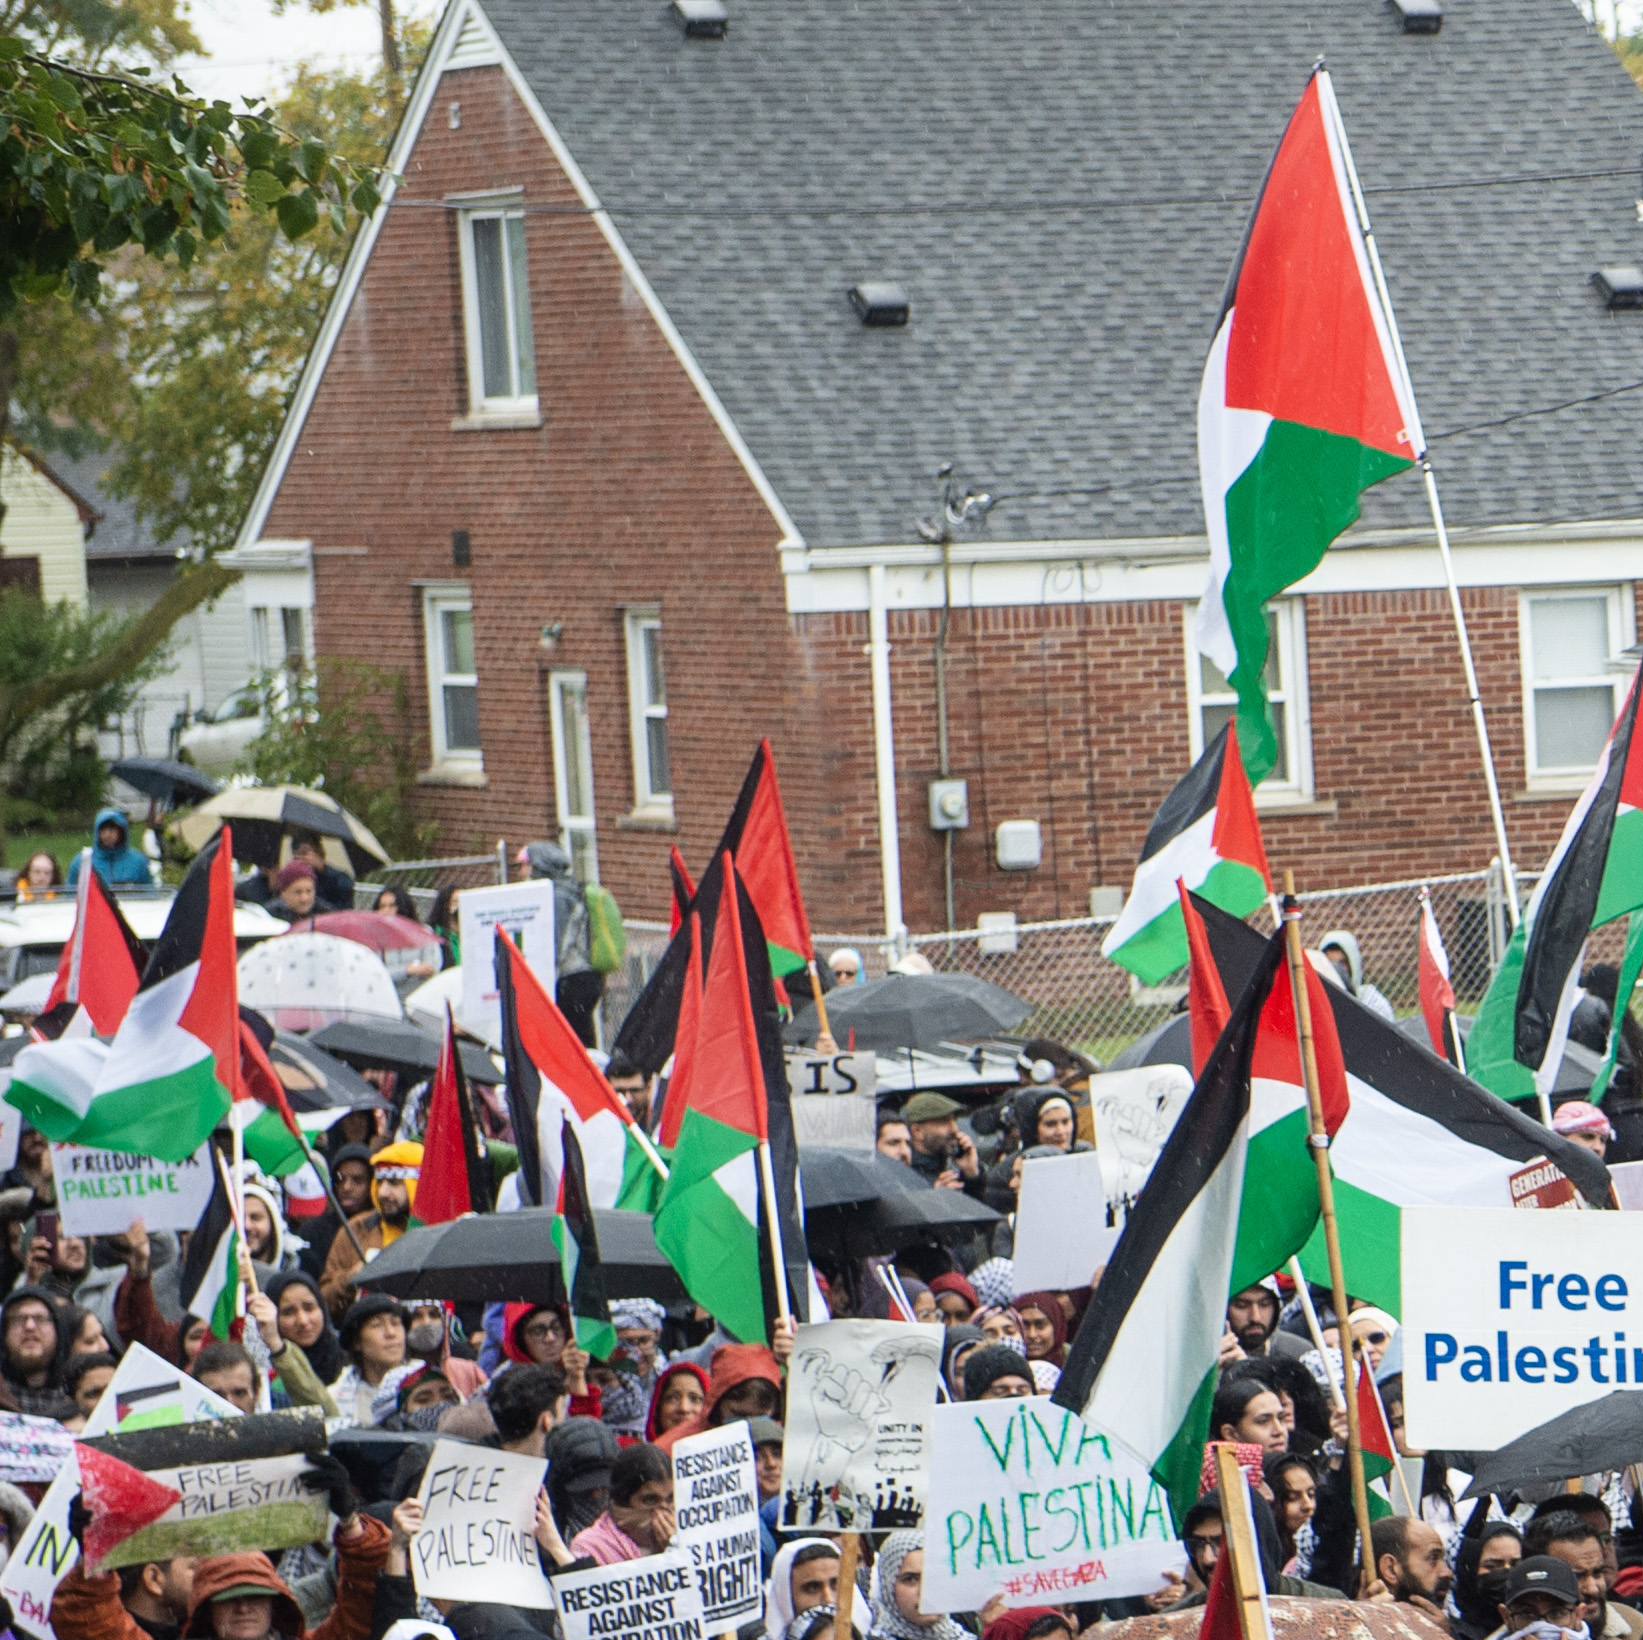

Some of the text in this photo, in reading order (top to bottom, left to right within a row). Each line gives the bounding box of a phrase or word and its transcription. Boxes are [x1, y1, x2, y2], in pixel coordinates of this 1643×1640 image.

[803, 1056, 857, 1094] IS
[62, 1172, 180, 1200] PALESTINE
[1511, 1163, 1567, 1198] GENERATI
[1499, 1261, 1629, 1311] Free
[878, 1423, 923, 1434] UNITY IN
[975, 1404, 1111, 1476] VIVA
[178, 1462, 254, 1492] FREE
[675, 1441, 749, 1480] RESISTANCE
[422, 1464, 505, 1520] FREE
[691, 1469, 742, 1502] AGAINST
[678, 1491, 755, 1530] OCCUPATION
[946, 1476, 1169, 1576] PALESTINA
[417, 1519, 537, 1579] PALESTINE
[688, 1530, 758, 1566] S A HUMAN
[560, 1566, 691, 1613] RESISTANCE
[589, 1597, 675, 1636] AGAINST
